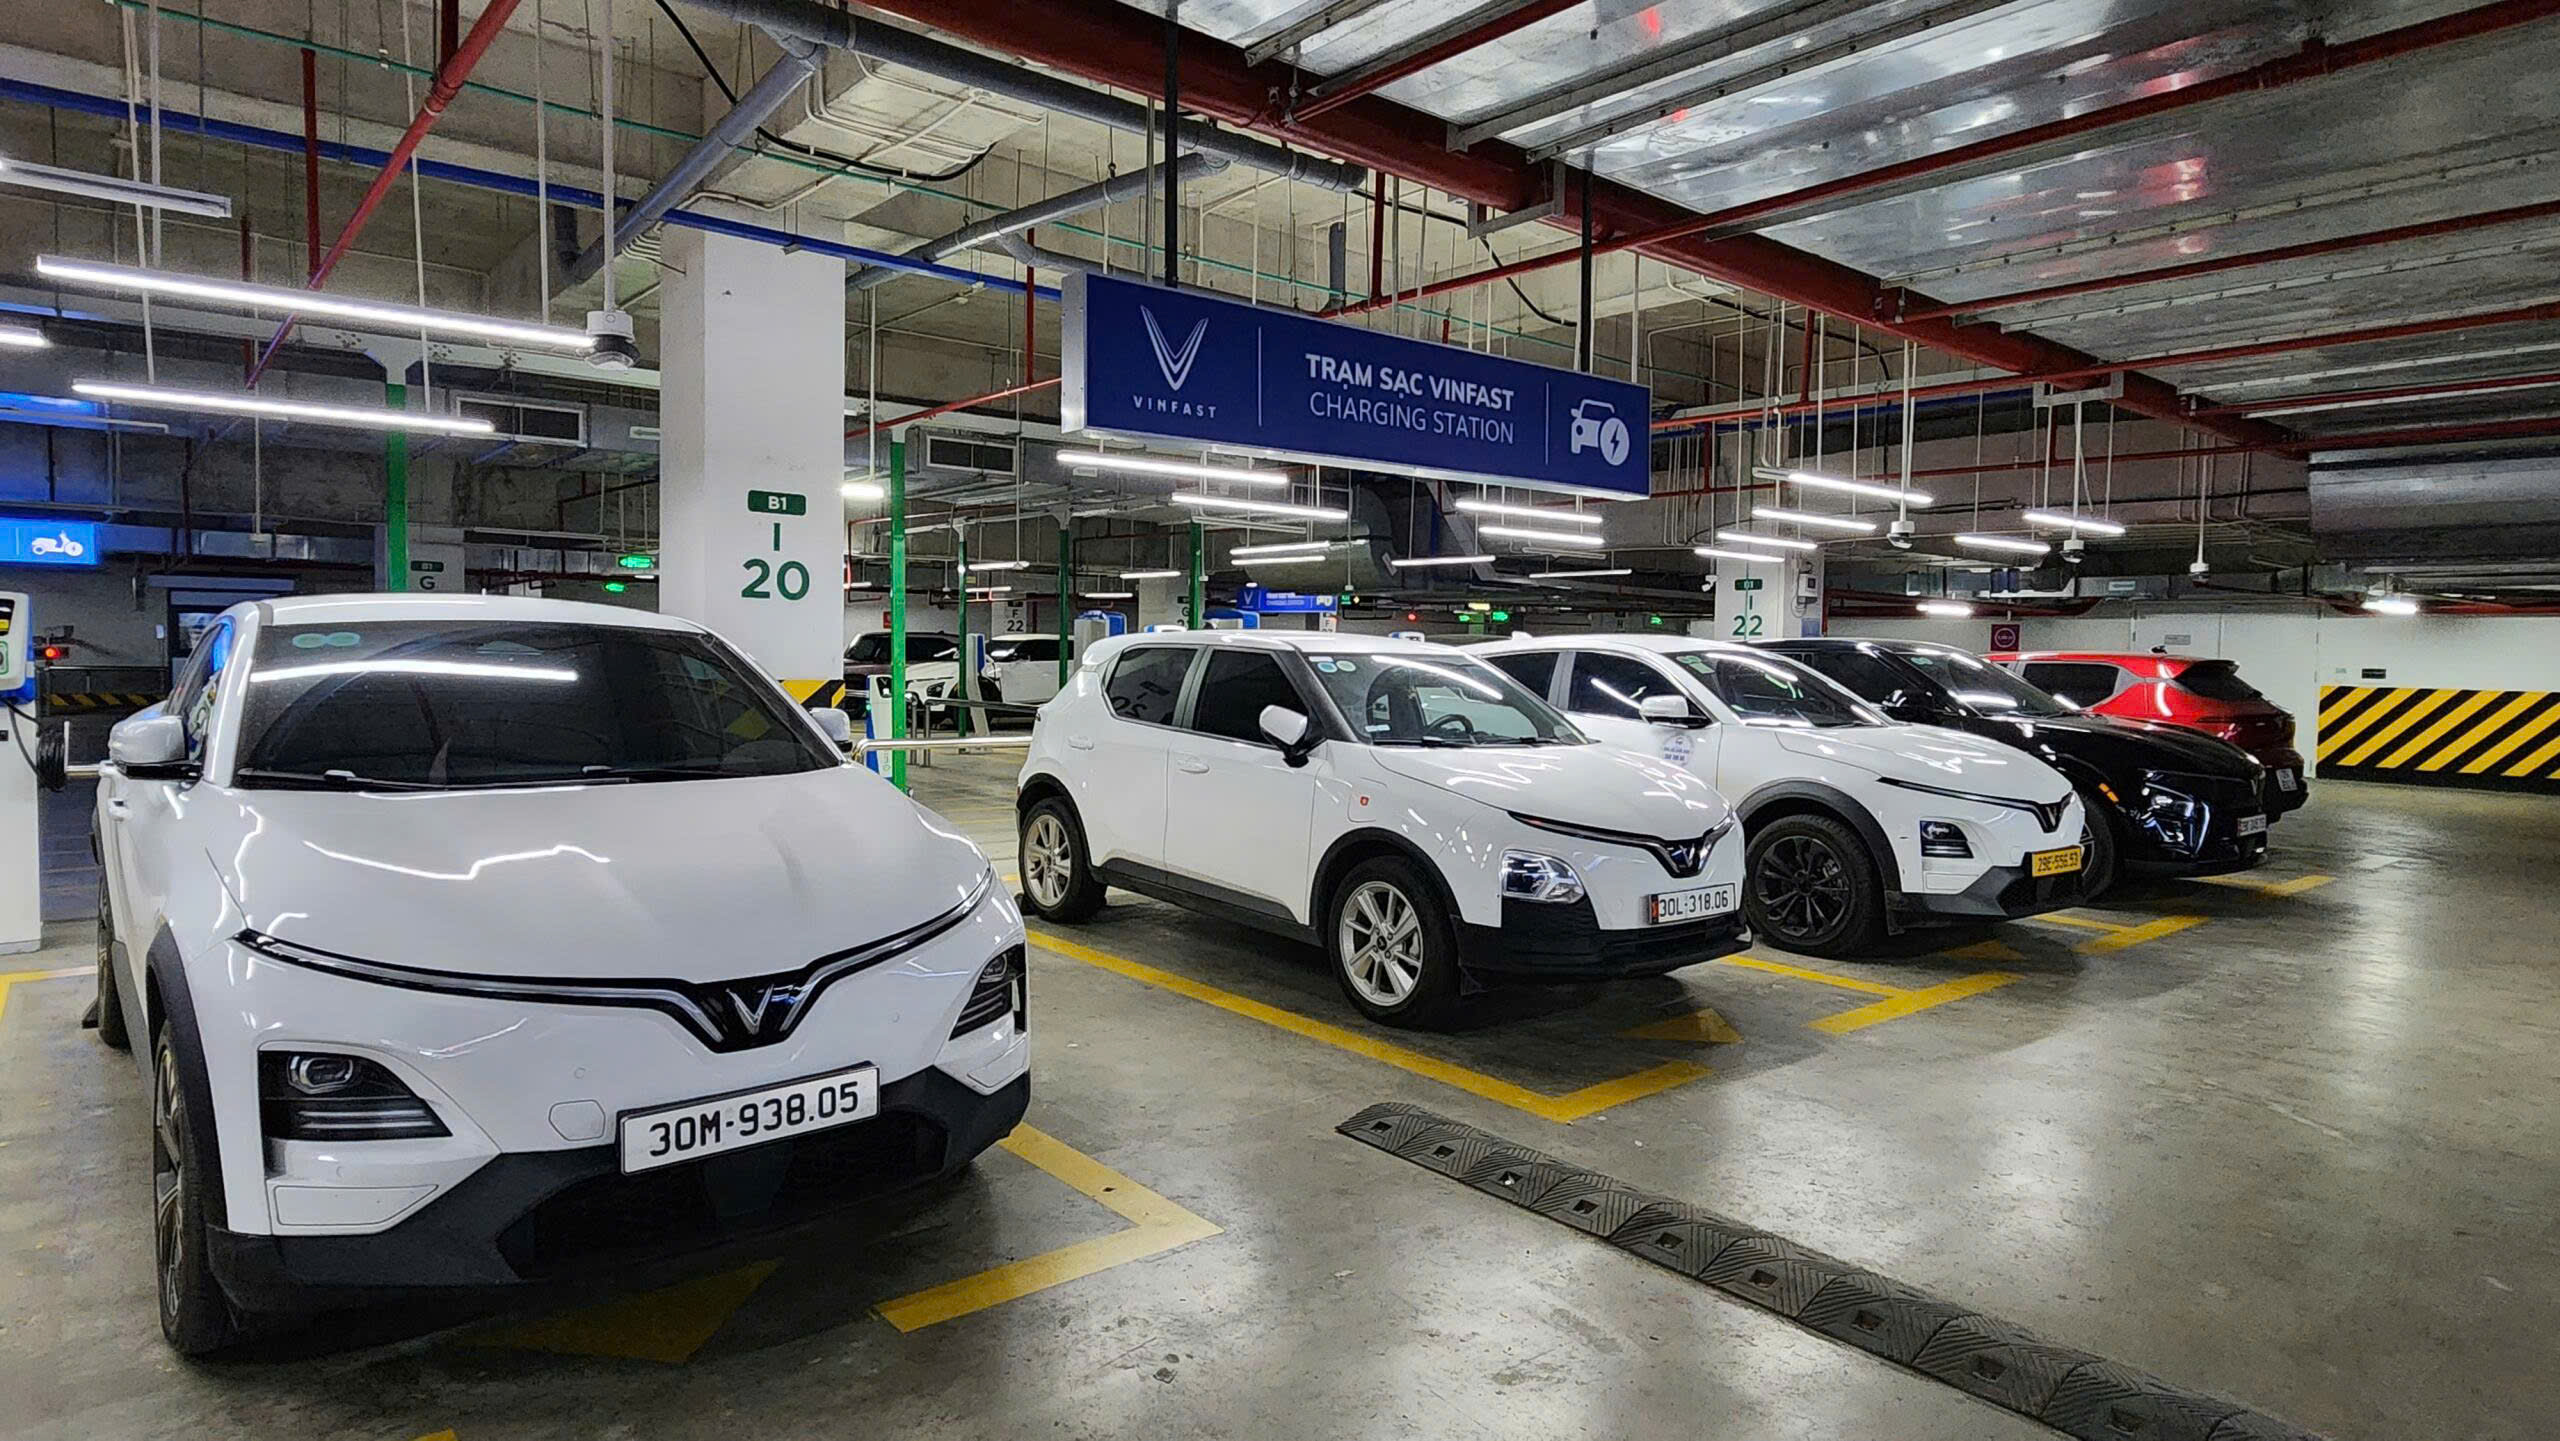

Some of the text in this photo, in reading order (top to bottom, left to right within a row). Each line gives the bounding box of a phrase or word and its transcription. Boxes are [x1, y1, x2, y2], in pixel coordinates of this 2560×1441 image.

[1306, 353, 1514, 412] TRẠM SẠC VINFAST
[1133, 395, 1217, 419] VINFAST
[1310, 391, 1514, 445] CHARGING STATION
[768, 496, 787, 511] B1
[420, 575, 435, 590] G
[741, 558, 810, 601] 20
[1006, 619, 1024, 632] 22
[1012, 609, 1019, 618] F
[1732, 615, 1763, 636] 22
[1659, 889, 1729, 917] 30L-318.06
[649, 1080, 859, 1157] 30M-938.05
